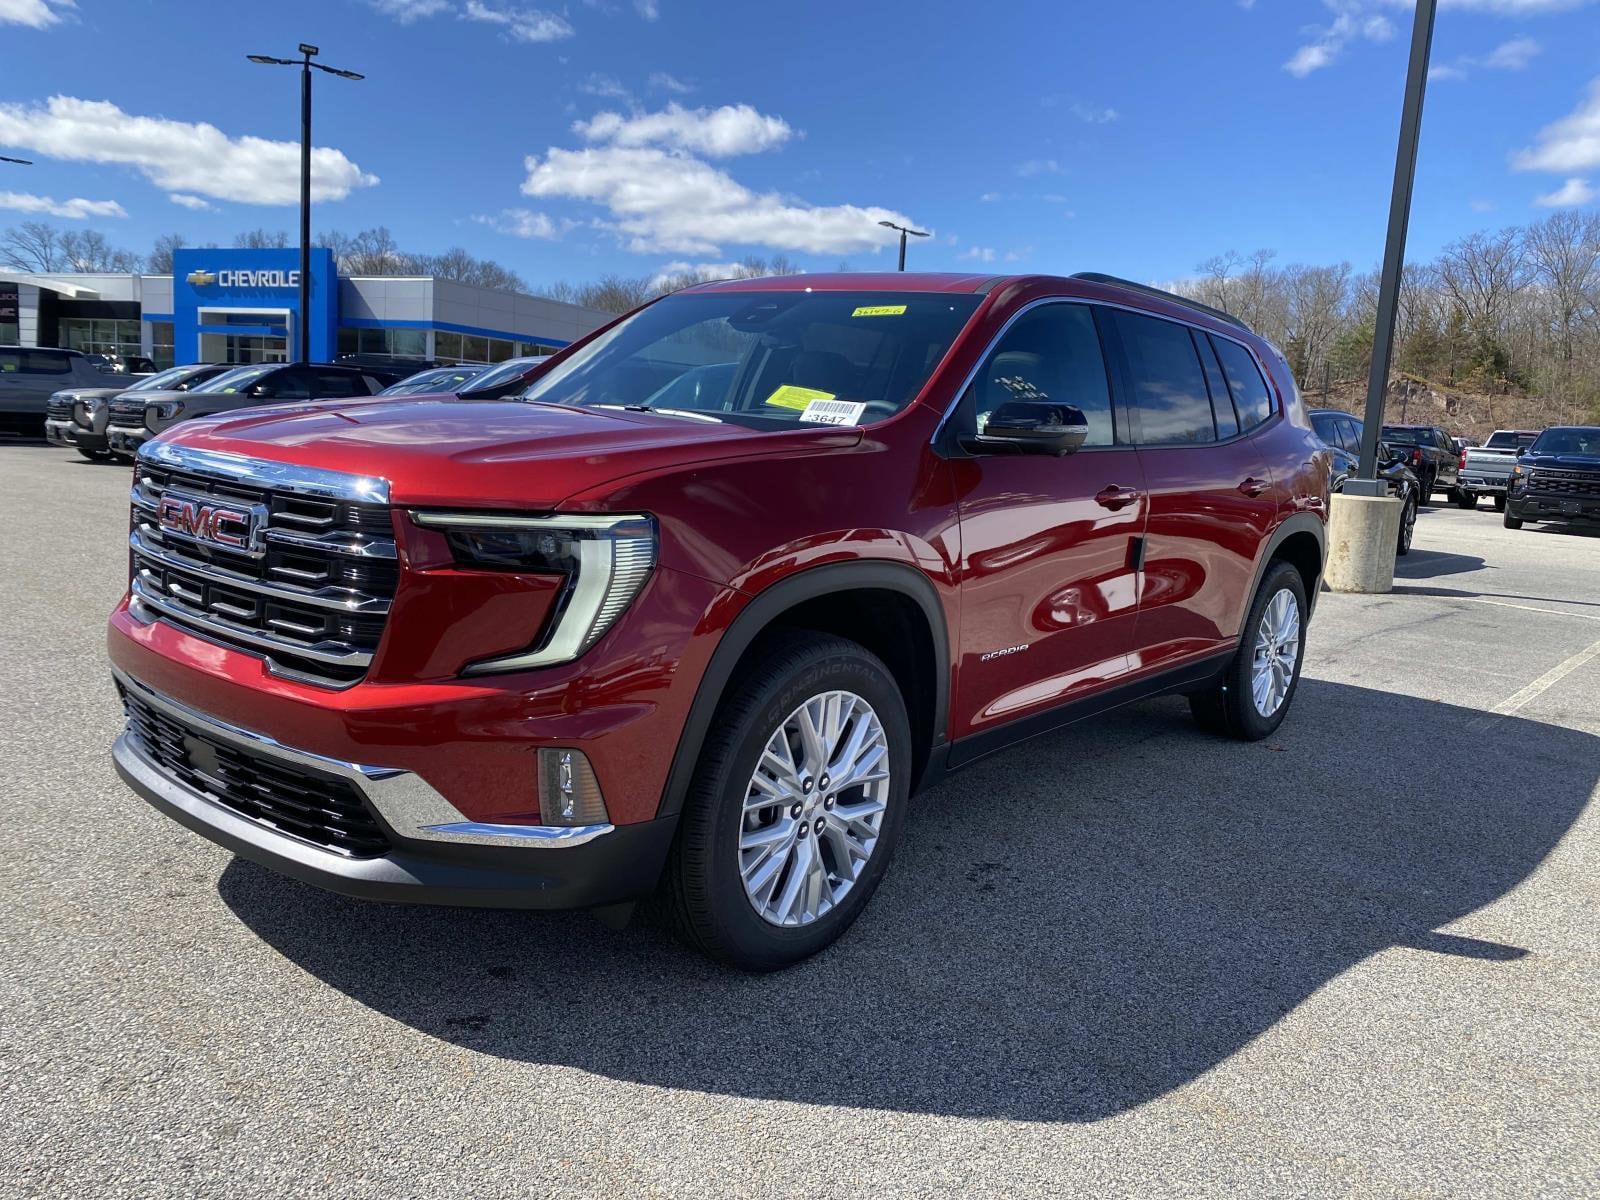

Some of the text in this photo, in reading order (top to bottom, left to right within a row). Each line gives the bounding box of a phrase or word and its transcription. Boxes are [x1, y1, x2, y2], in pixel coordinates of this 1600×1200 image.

[218, 270, 303, 287] CHEVROLE
[811, 414, 846, 424] 3647
[158, 496, 246, 545] GMC
[981, 644, 1029, 662] ACADIA
